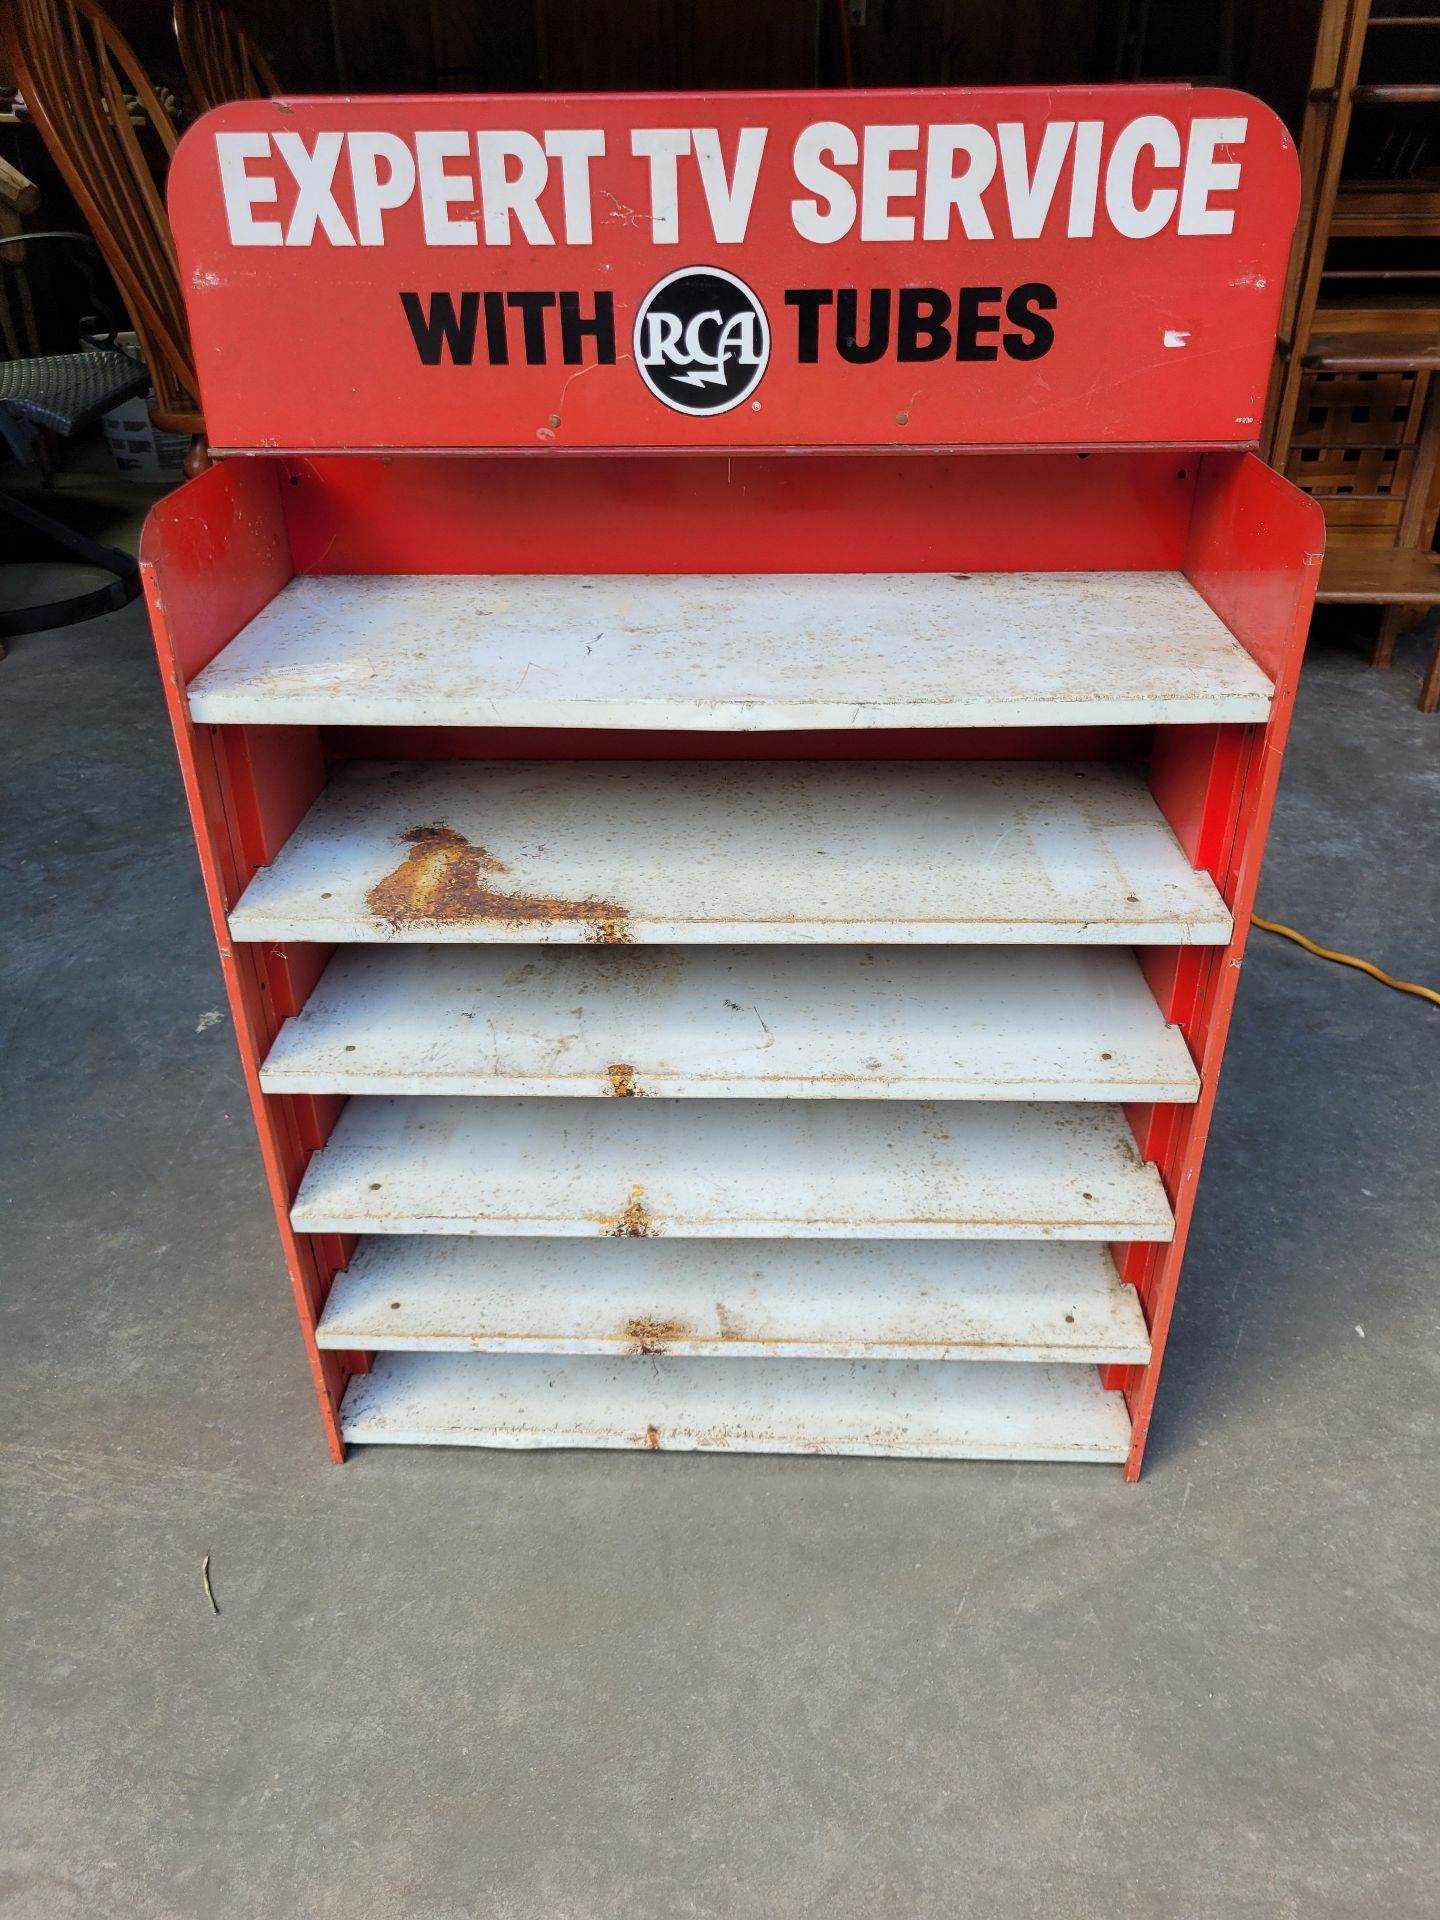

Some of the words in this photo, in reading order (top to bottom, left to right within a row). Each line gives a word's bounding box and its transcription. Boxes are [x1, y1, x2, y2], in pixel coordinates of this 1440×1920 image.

[215, 129, 606, 247] EXPERT
[630, 127, 769, 245] TV
[790, 115, 1249, 244] SERVICE
[400, 291, 617, 366] WITH
[642, 309, 760, 380] RCA
[784, 283, 1057, 364] TUBES
